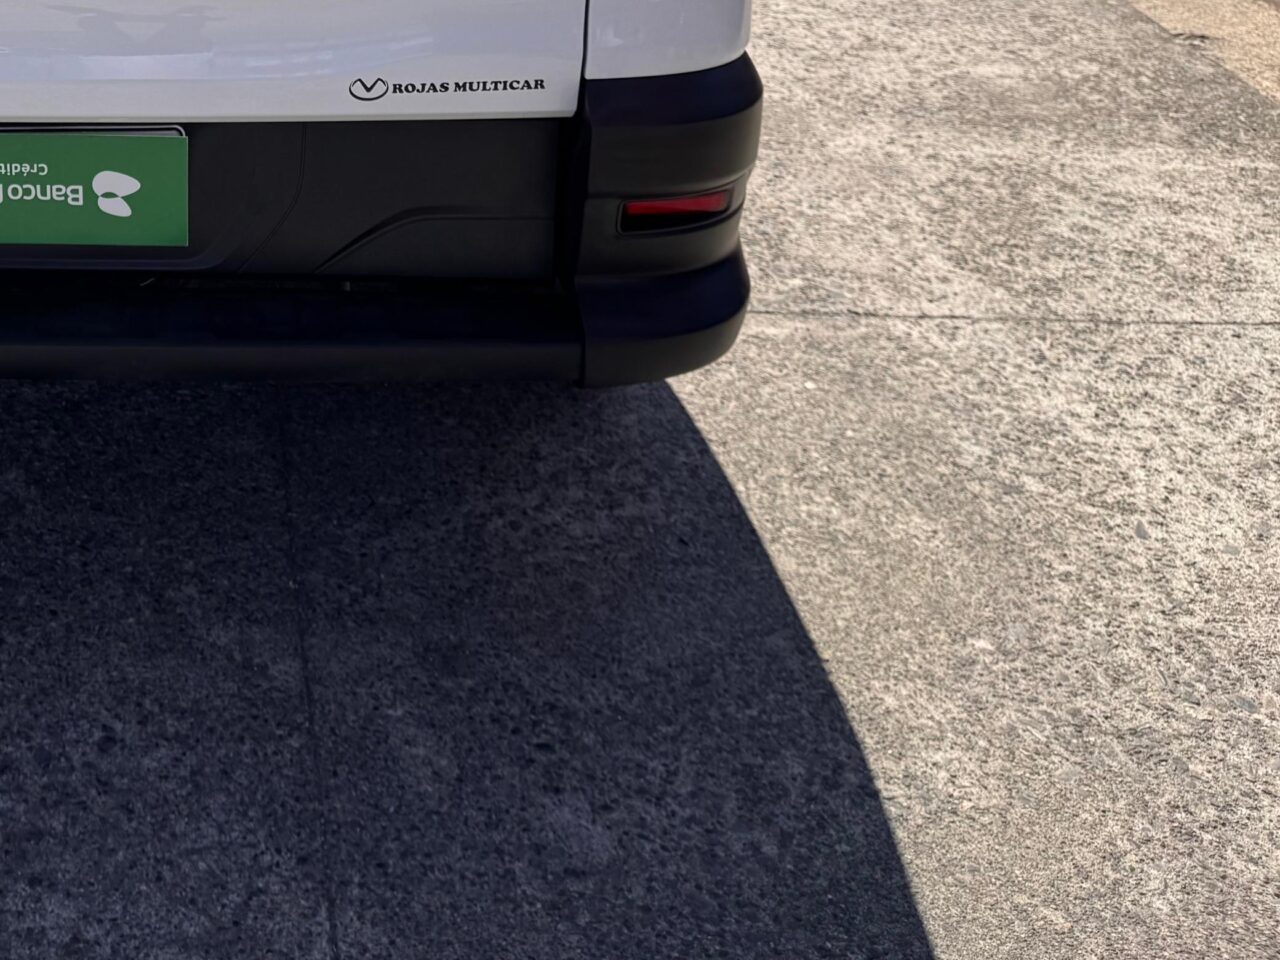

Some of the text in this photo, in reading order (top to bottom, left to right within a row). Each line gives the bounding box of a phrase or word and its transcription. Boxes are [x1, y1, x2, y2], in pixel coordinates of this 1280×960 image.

[392, 79, 546, 94] ROJAS MULTICAR
[7, 184, 84, 206] Banco
